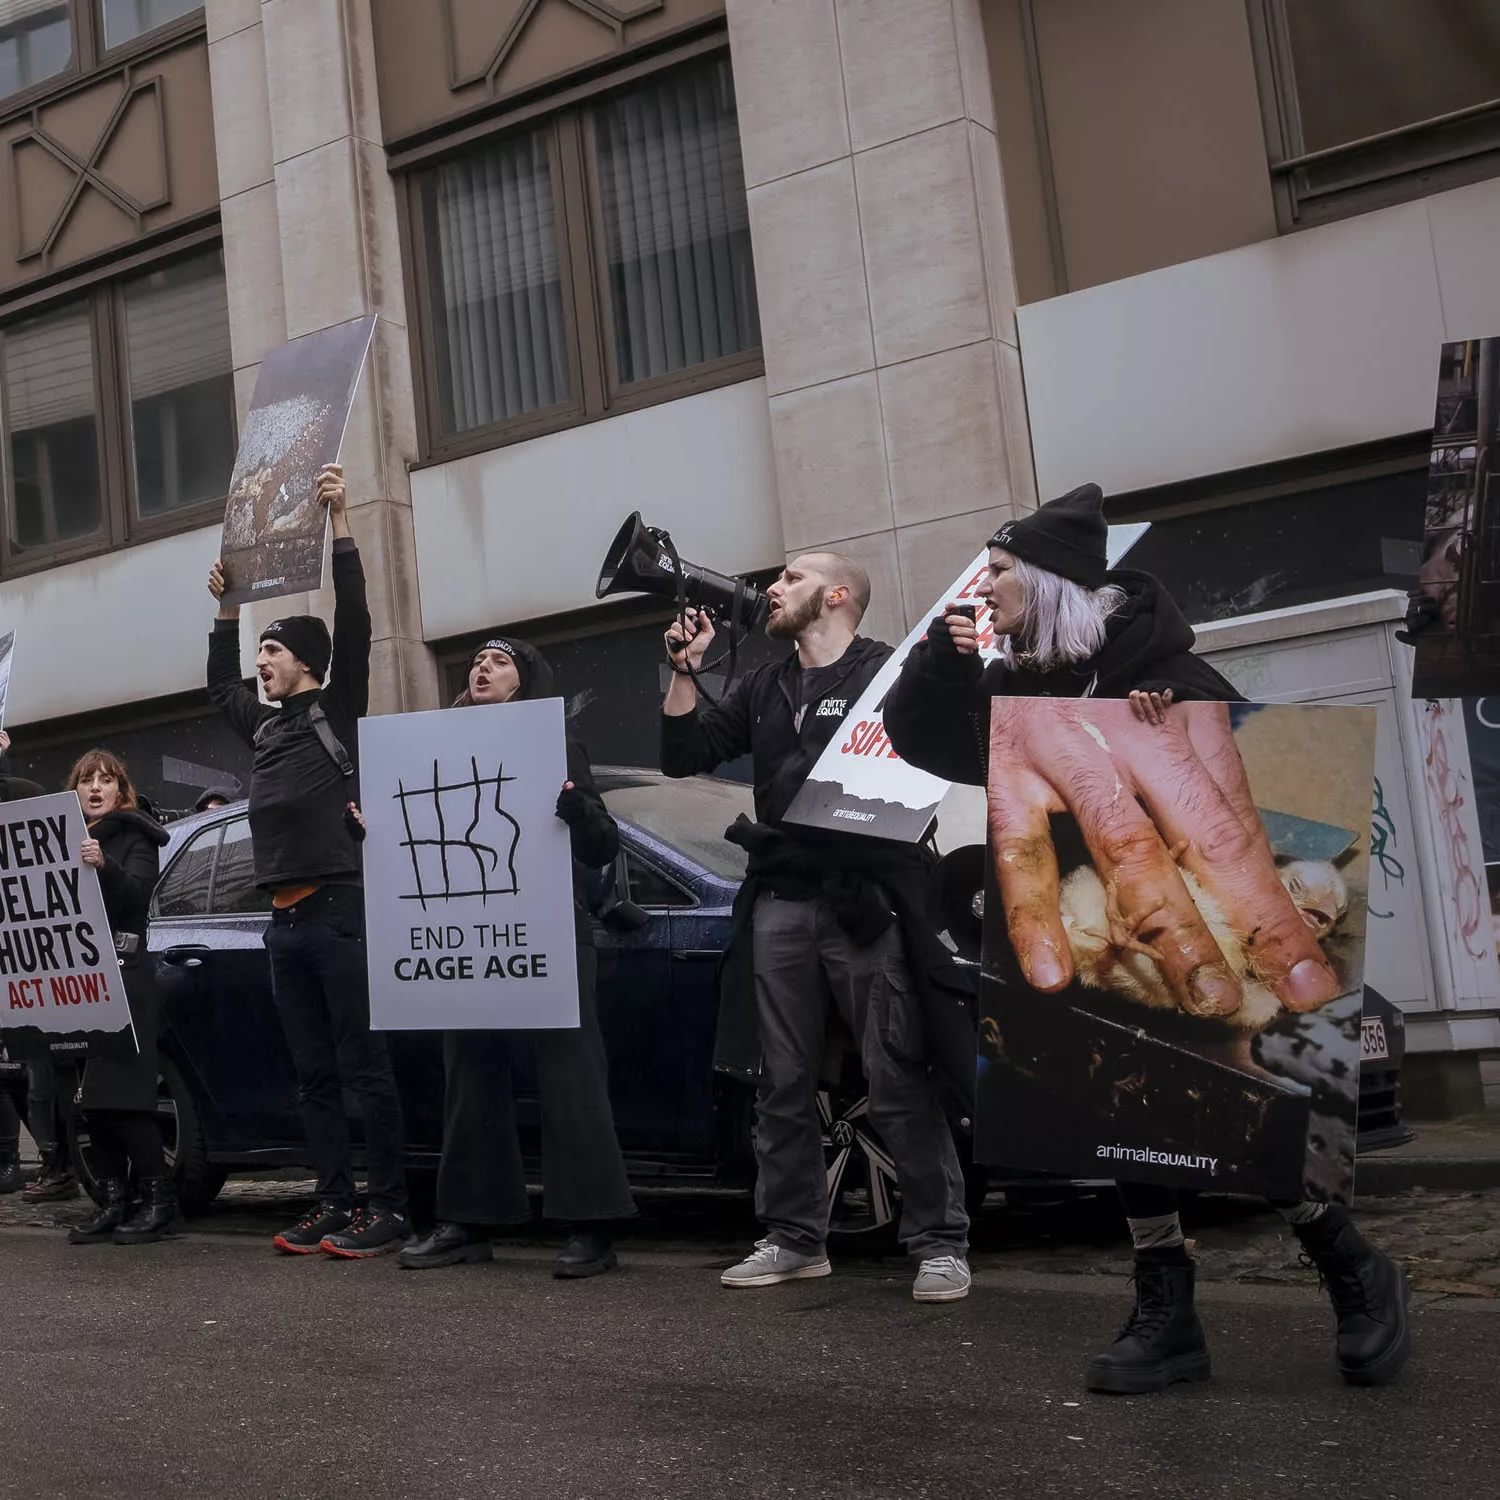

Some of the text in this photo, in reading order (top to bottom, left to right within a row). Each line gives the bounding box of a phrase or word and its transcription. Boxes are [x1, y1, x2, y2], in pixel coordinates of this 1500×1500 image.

[832, 807, 877, 823] animalEQUALITY
[410, 923, 528, 950] END THE
[394, 954, 548, 981] CAGE AGE
[8, 972, 111, 1010] ACT NOW!
[1096, 1143, 1218, 1170] animalEQUALITY
